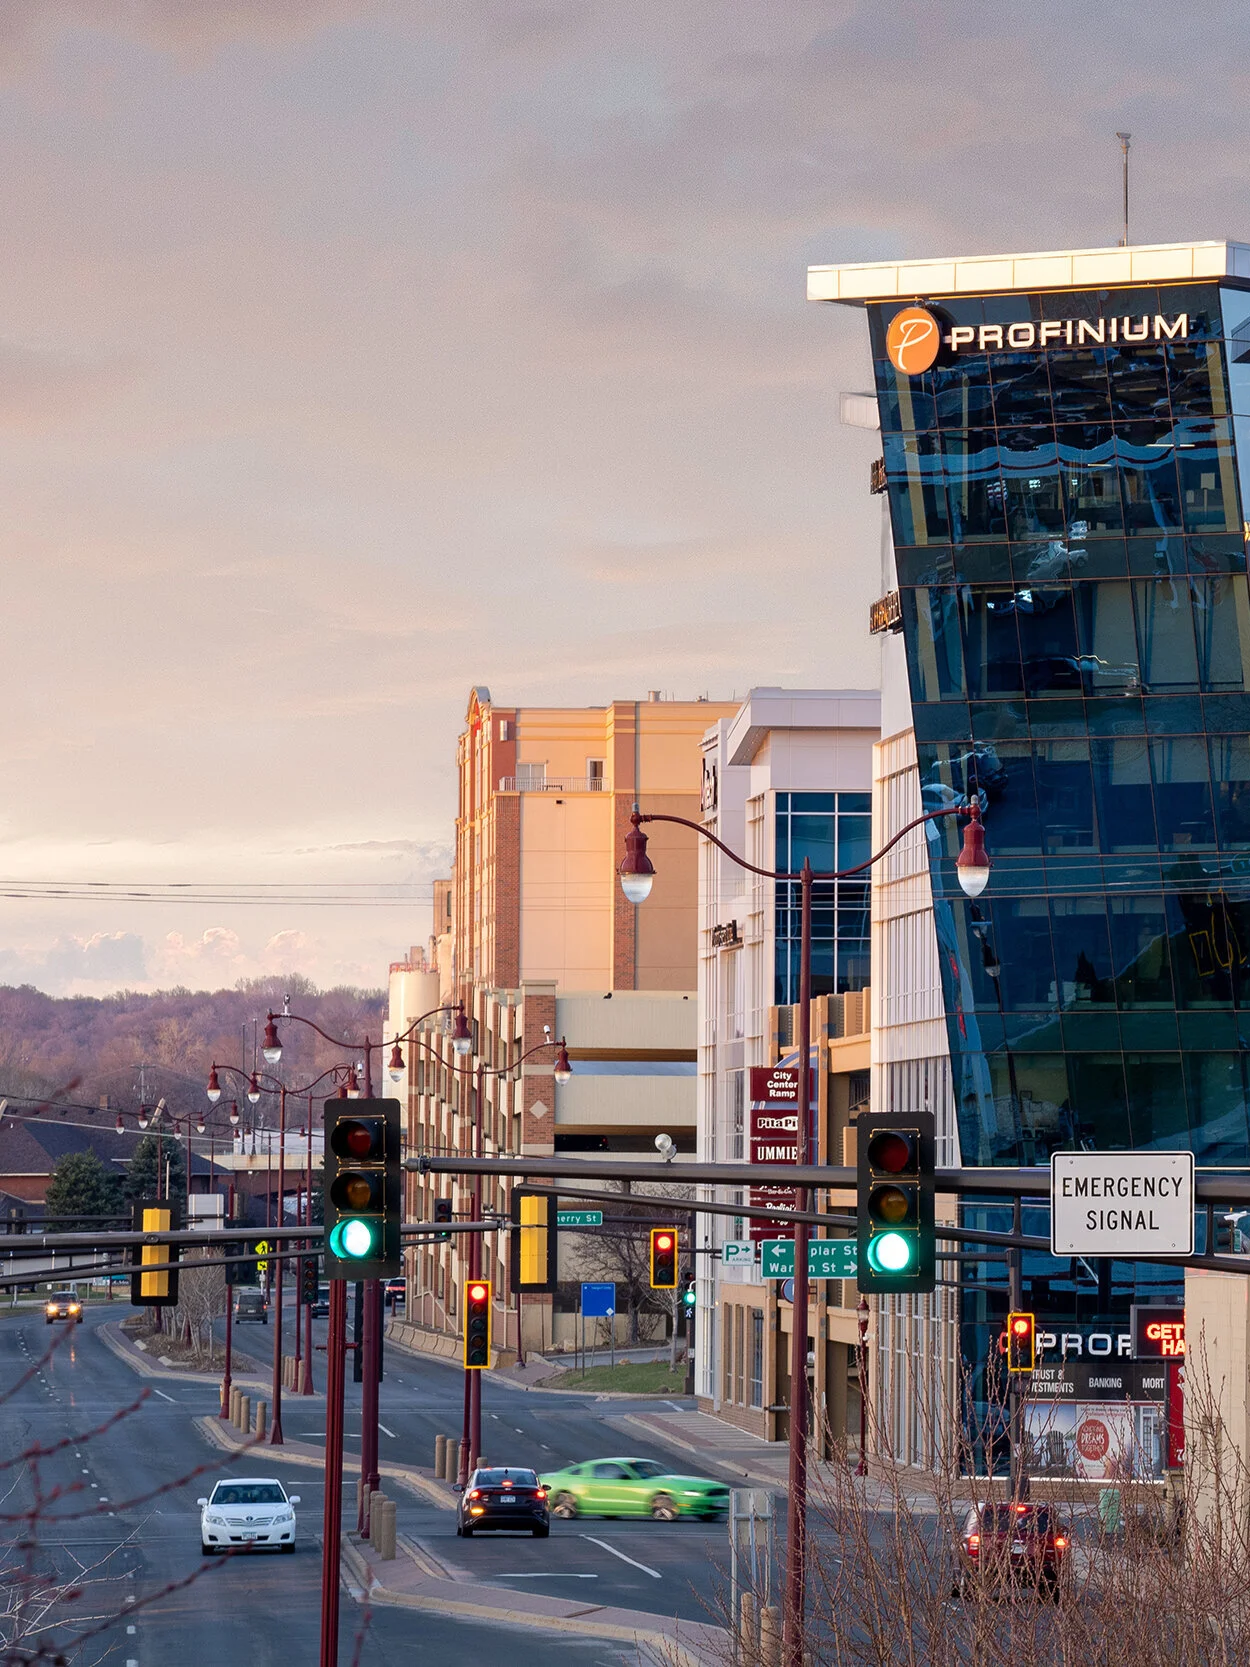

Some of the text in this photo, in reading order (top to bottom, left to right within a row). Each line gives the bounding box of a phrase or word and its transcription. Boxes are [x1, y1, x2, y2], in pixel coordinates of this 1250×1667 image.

[950, 312, 1188, 352] PROFINIUM
[773, 1071, 792, 1081] City
[766, 1080, 798, 1089] Center
[769, 1089, 796, 1099] Ramp
[1062, 1177, 1184, 1198] EMERGENCY
[585, 1214, 597, 1223] St
[1086, 1209, 1160, 1231] SIGNAL
[843, 1245, 857, 1256] St
[822, 1262, 836, 1273] St
[1146, 1323, 1185, 1340] GET
[1088, 1377, 1123, 1389] BANKING
